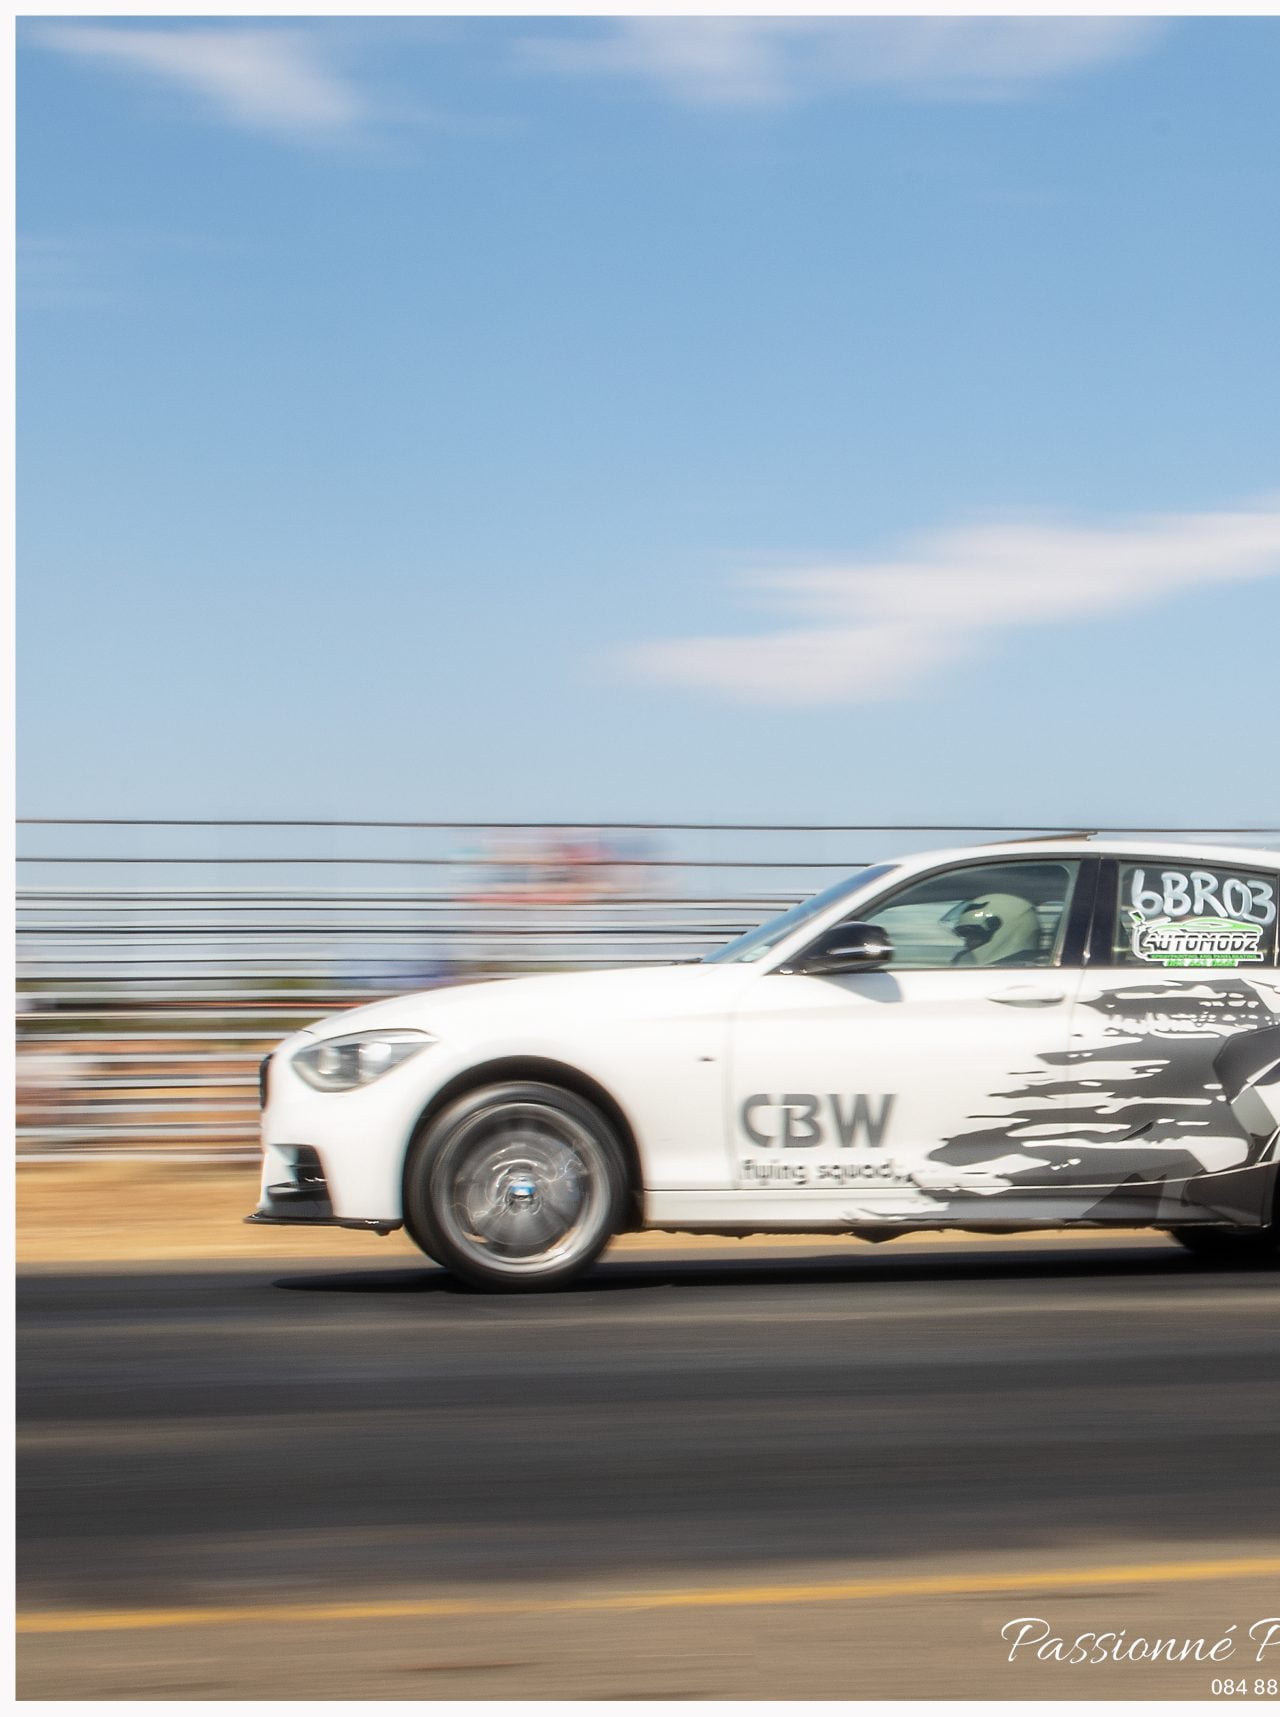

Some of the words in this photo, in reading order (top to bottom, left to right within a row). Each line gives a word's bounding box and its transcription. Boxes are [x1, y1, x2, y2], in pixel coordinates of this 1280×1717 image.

[1144, 932, 1258, 951] AUTOMODZ
[741, 1093, 896, 1148] CBW
[741, 1159, 807, 1186] flying
